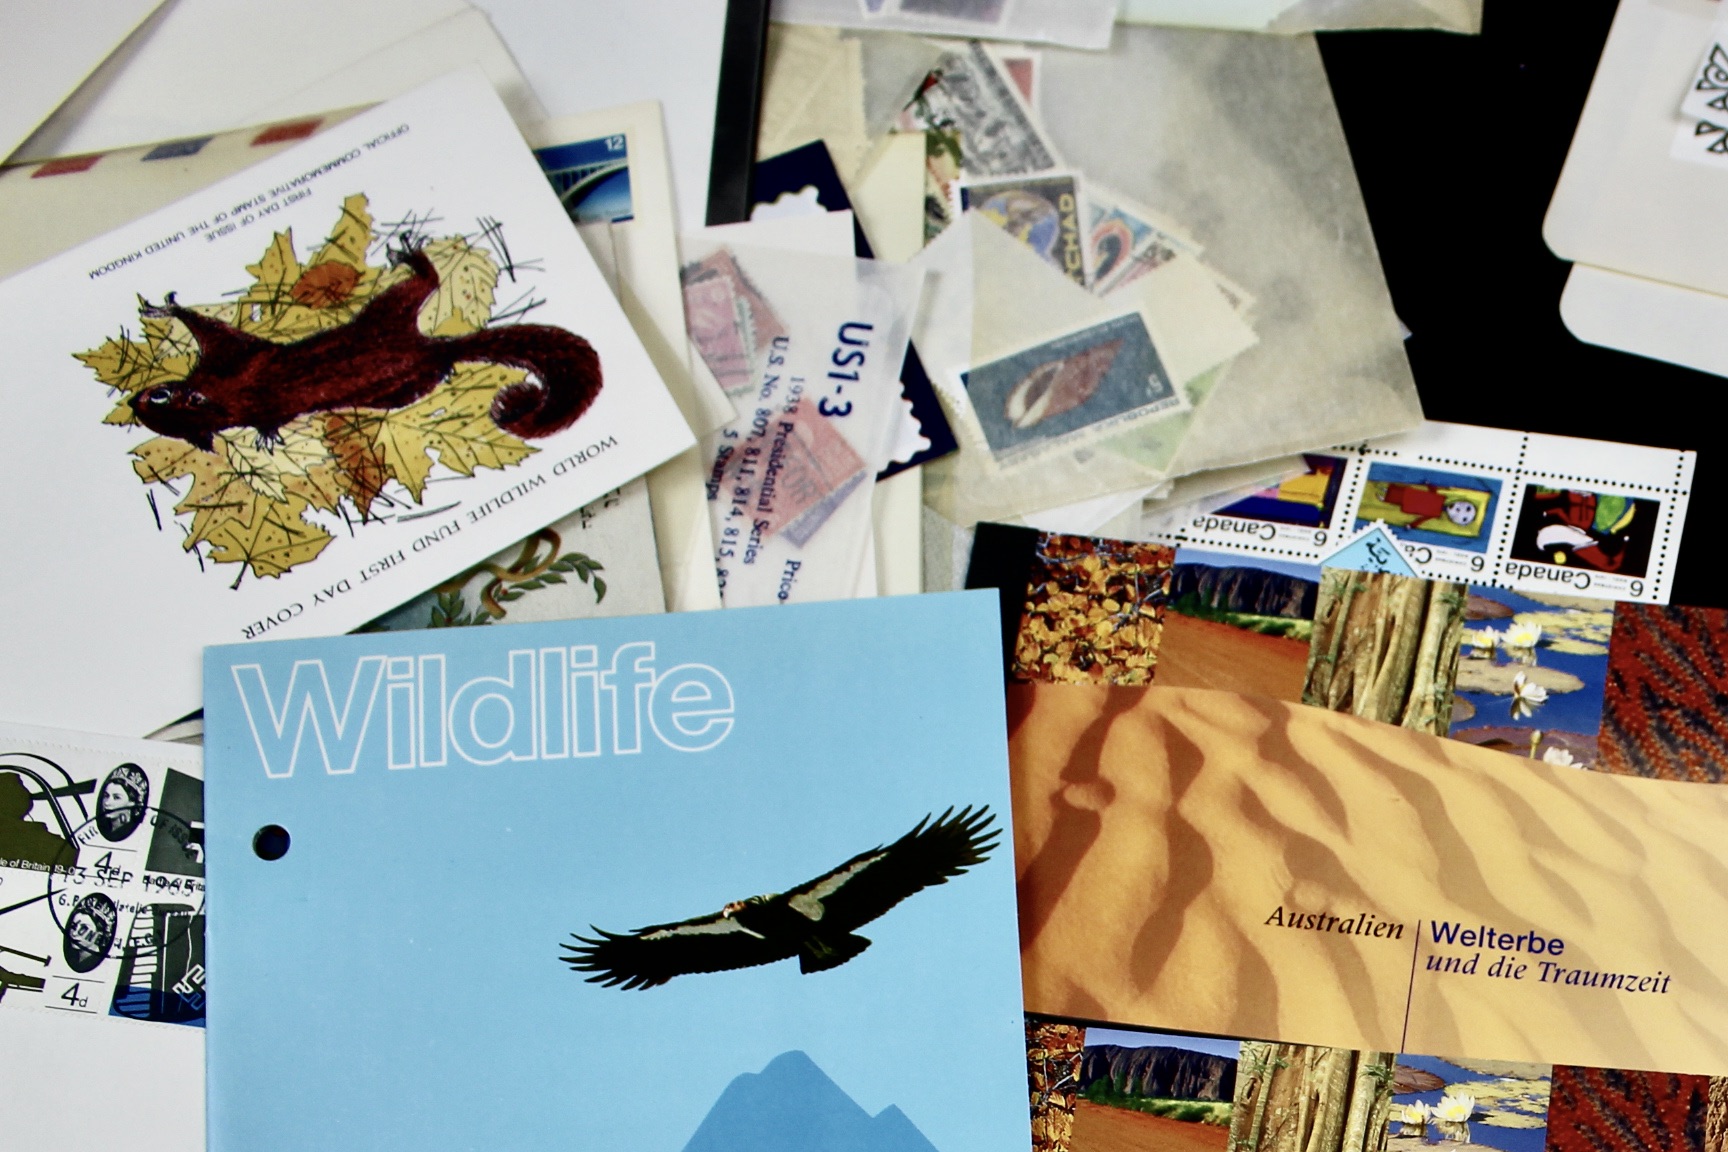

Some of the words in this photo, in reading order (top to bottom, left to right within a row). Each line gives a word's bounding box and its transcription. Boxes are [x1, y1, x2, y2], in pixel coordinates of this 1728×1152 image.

[363, 123, 410, 151] OFFICIAL
[604, 134, 625, 152] 12
[280, 147, 361, 194] COMMEMORATIVE
[231, 191, 267, 214] STAMP
[283, 186, 312, 207] FIRST
[213, 211, 229, 225] OF
[239, 213, 255, 227] OF
[257, 203, 280, 220] DAY
[187, 219, 210, 236] THE
[205, 222, 238, 243] ISSUE
[145, 229, 188, 255] UNITED
[89, 249, 143, 281] KINGDOM
[817, 320, 874, 418] US1-3
[553, 434, 618, 477] WORLD
[760, 420, 795, 514] Presidential
[467, 473, 547, 525] WILDLIFE
[411, 520, 461, 554] FUND
[743, 514, 770, 566] Series
[1192, 514, 1278, 542] Canada
[1313, 530, 1329, 548] 6
[360, 548, 406, 583] FIRST
[1469, 555, 1486, 573] 6
[1505, 560, 1592, 590] Canada
[313, 578, 352, 607] DAY
[1629, 579, 1645, 598] 6
[240, 602, 304, 641] COVER
[230, 641, 736, 780] Wildlife
[21, 859, 51, 872] Britain
[1263, 905, 1405, 940] Australien
[1429, 920, 1566, 956] Welterbe
[1425, 952, 1480, 975] und
[1487, 956, 1529, 980] die
[1536, 960, 1672, 995] Traumzeit
[60, 982, 88, 1008] 4d
